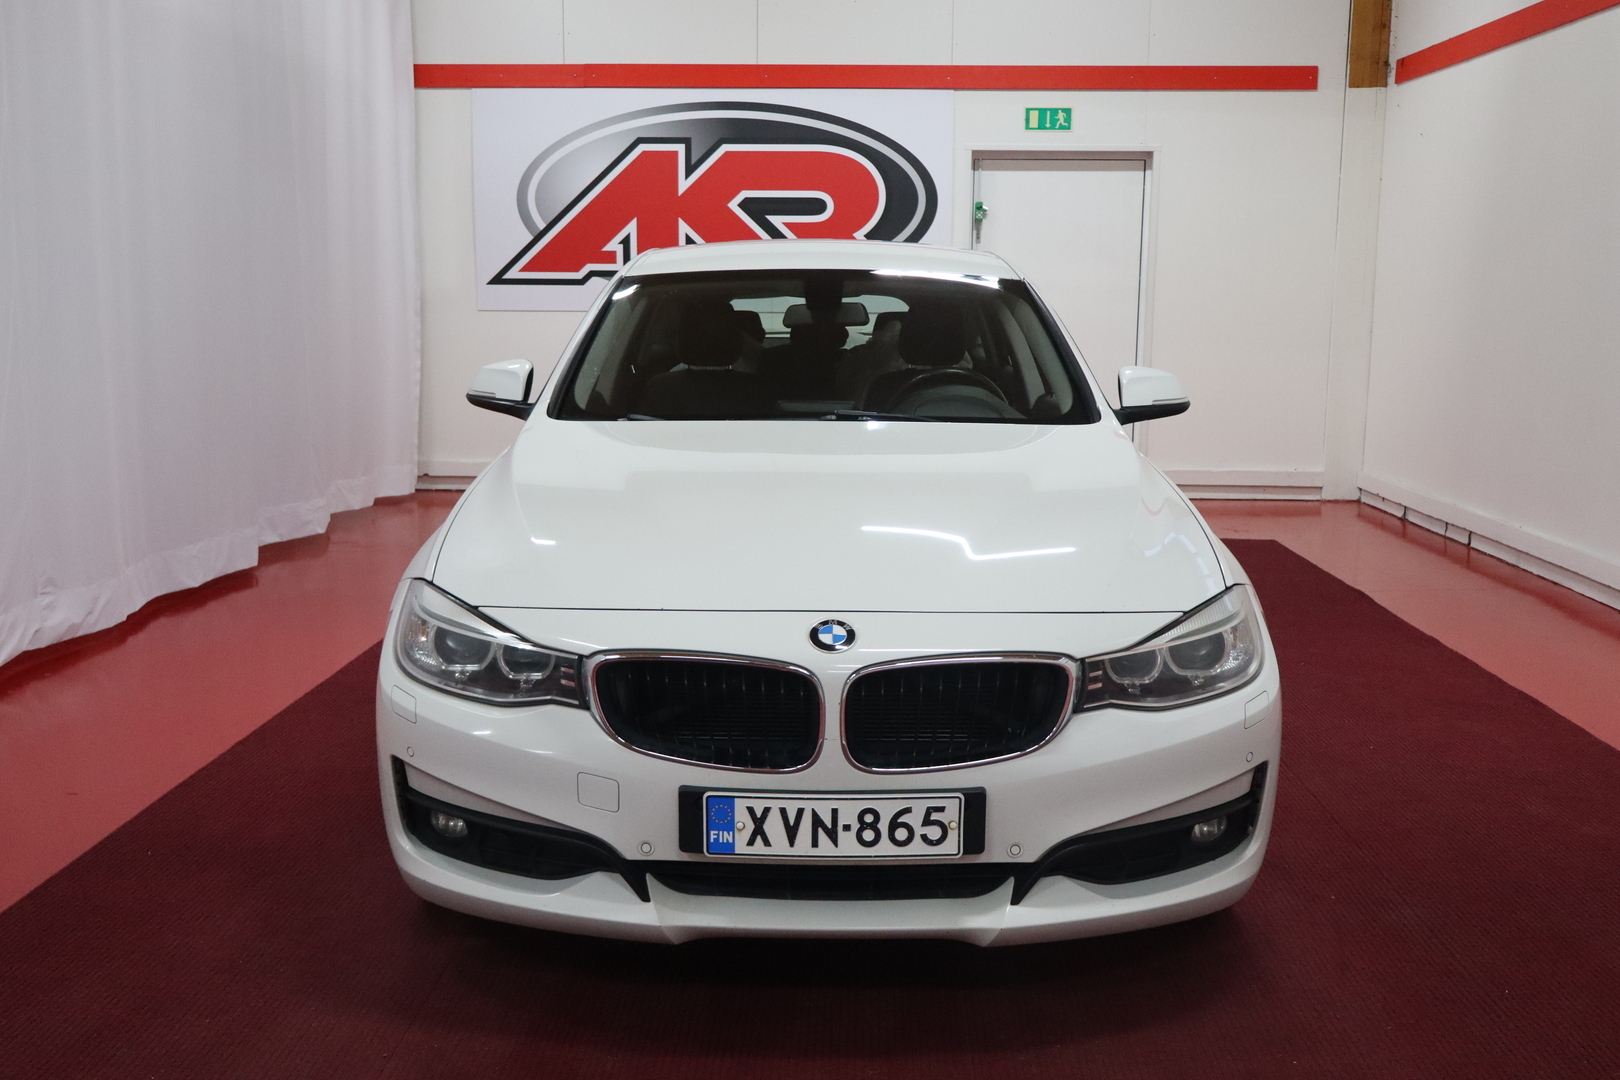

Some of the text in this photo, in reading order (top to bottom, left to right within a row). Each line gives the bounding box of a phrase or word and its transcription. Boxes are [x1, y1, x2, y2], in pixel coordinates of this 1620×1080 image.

[814, 620, 853, 631] BMW
[745, 805, 949, 848] XVN-865
[710, 830, 733, 843] FIN
